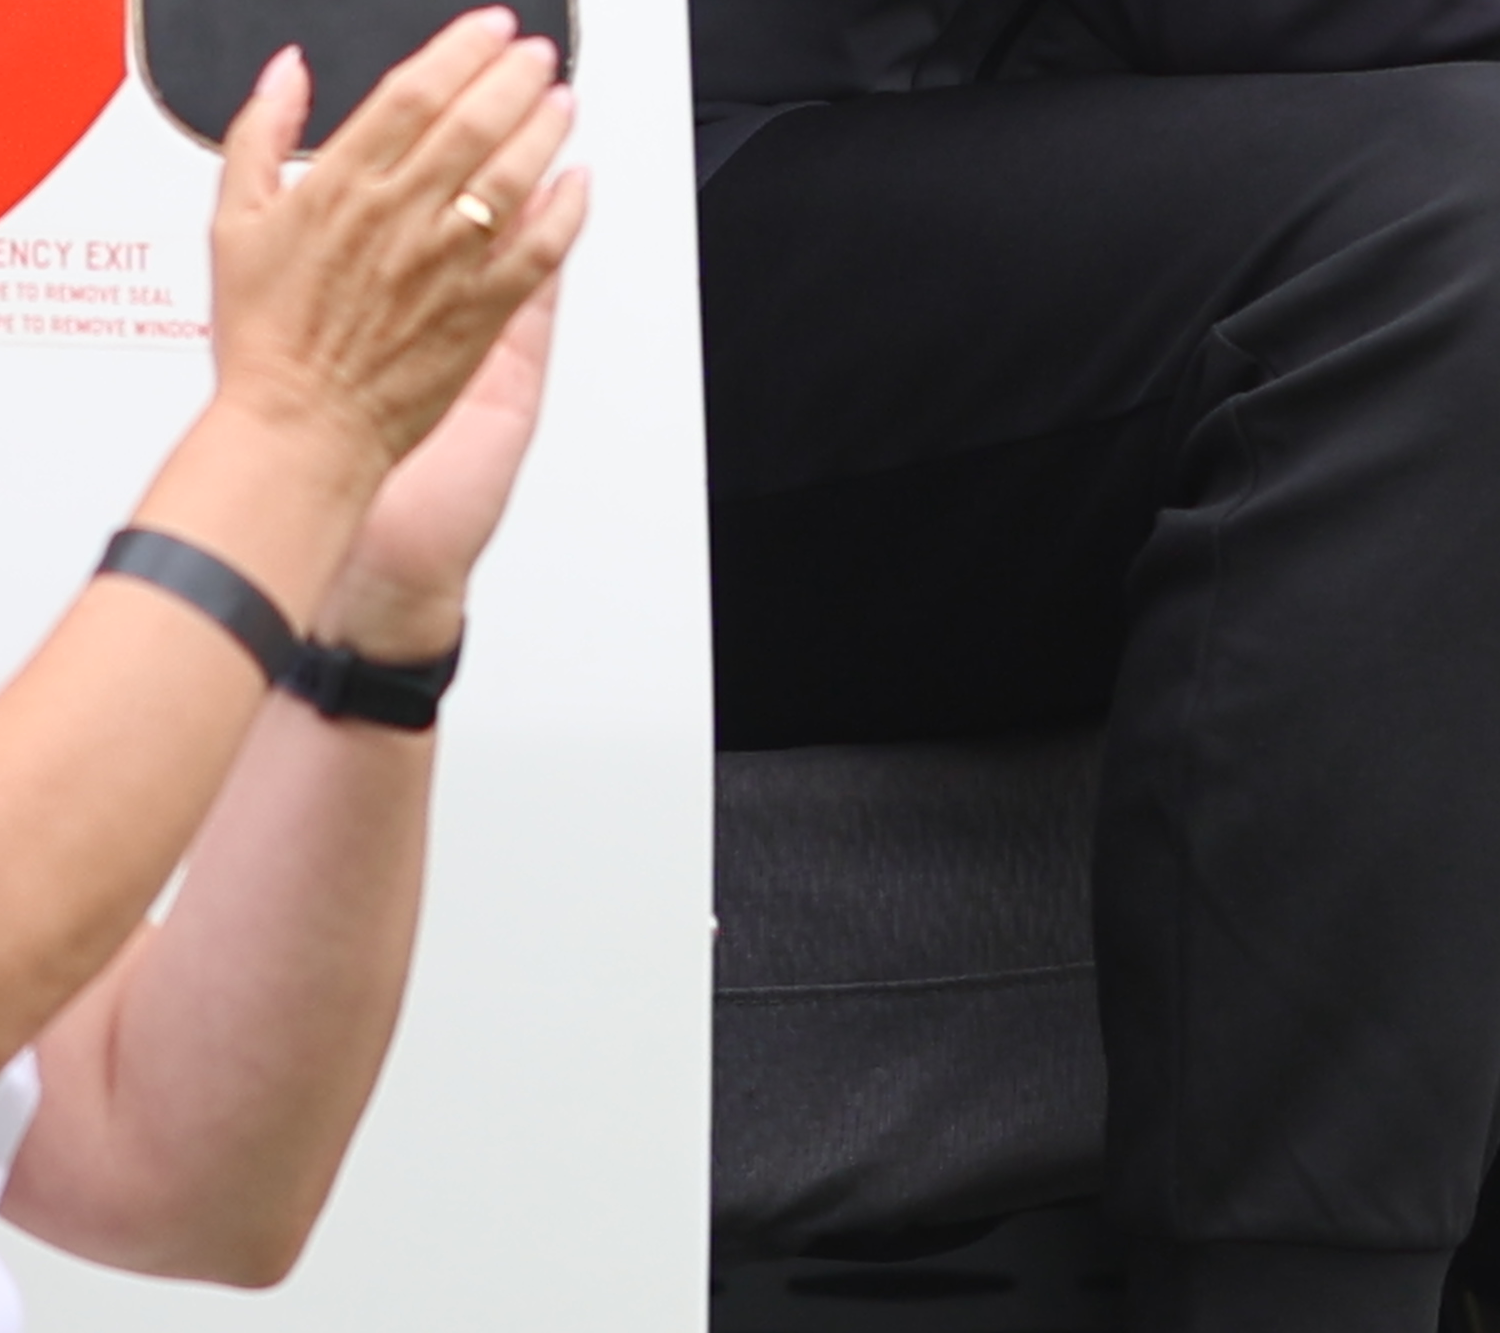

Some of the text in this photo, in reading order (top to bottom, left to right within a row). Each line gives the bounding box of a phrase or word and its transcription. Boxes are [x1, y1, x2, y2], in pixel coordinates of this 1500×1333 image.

[85, 239, 151, 272] EXIT
[17, 281, 39, 302] TO
[46, 283, 120, 305] REMOVE
[128, 285, 174, 307] SEAL
[23, 313, 44, 334] TO
[51, 314, 126, 336] REMOVE
